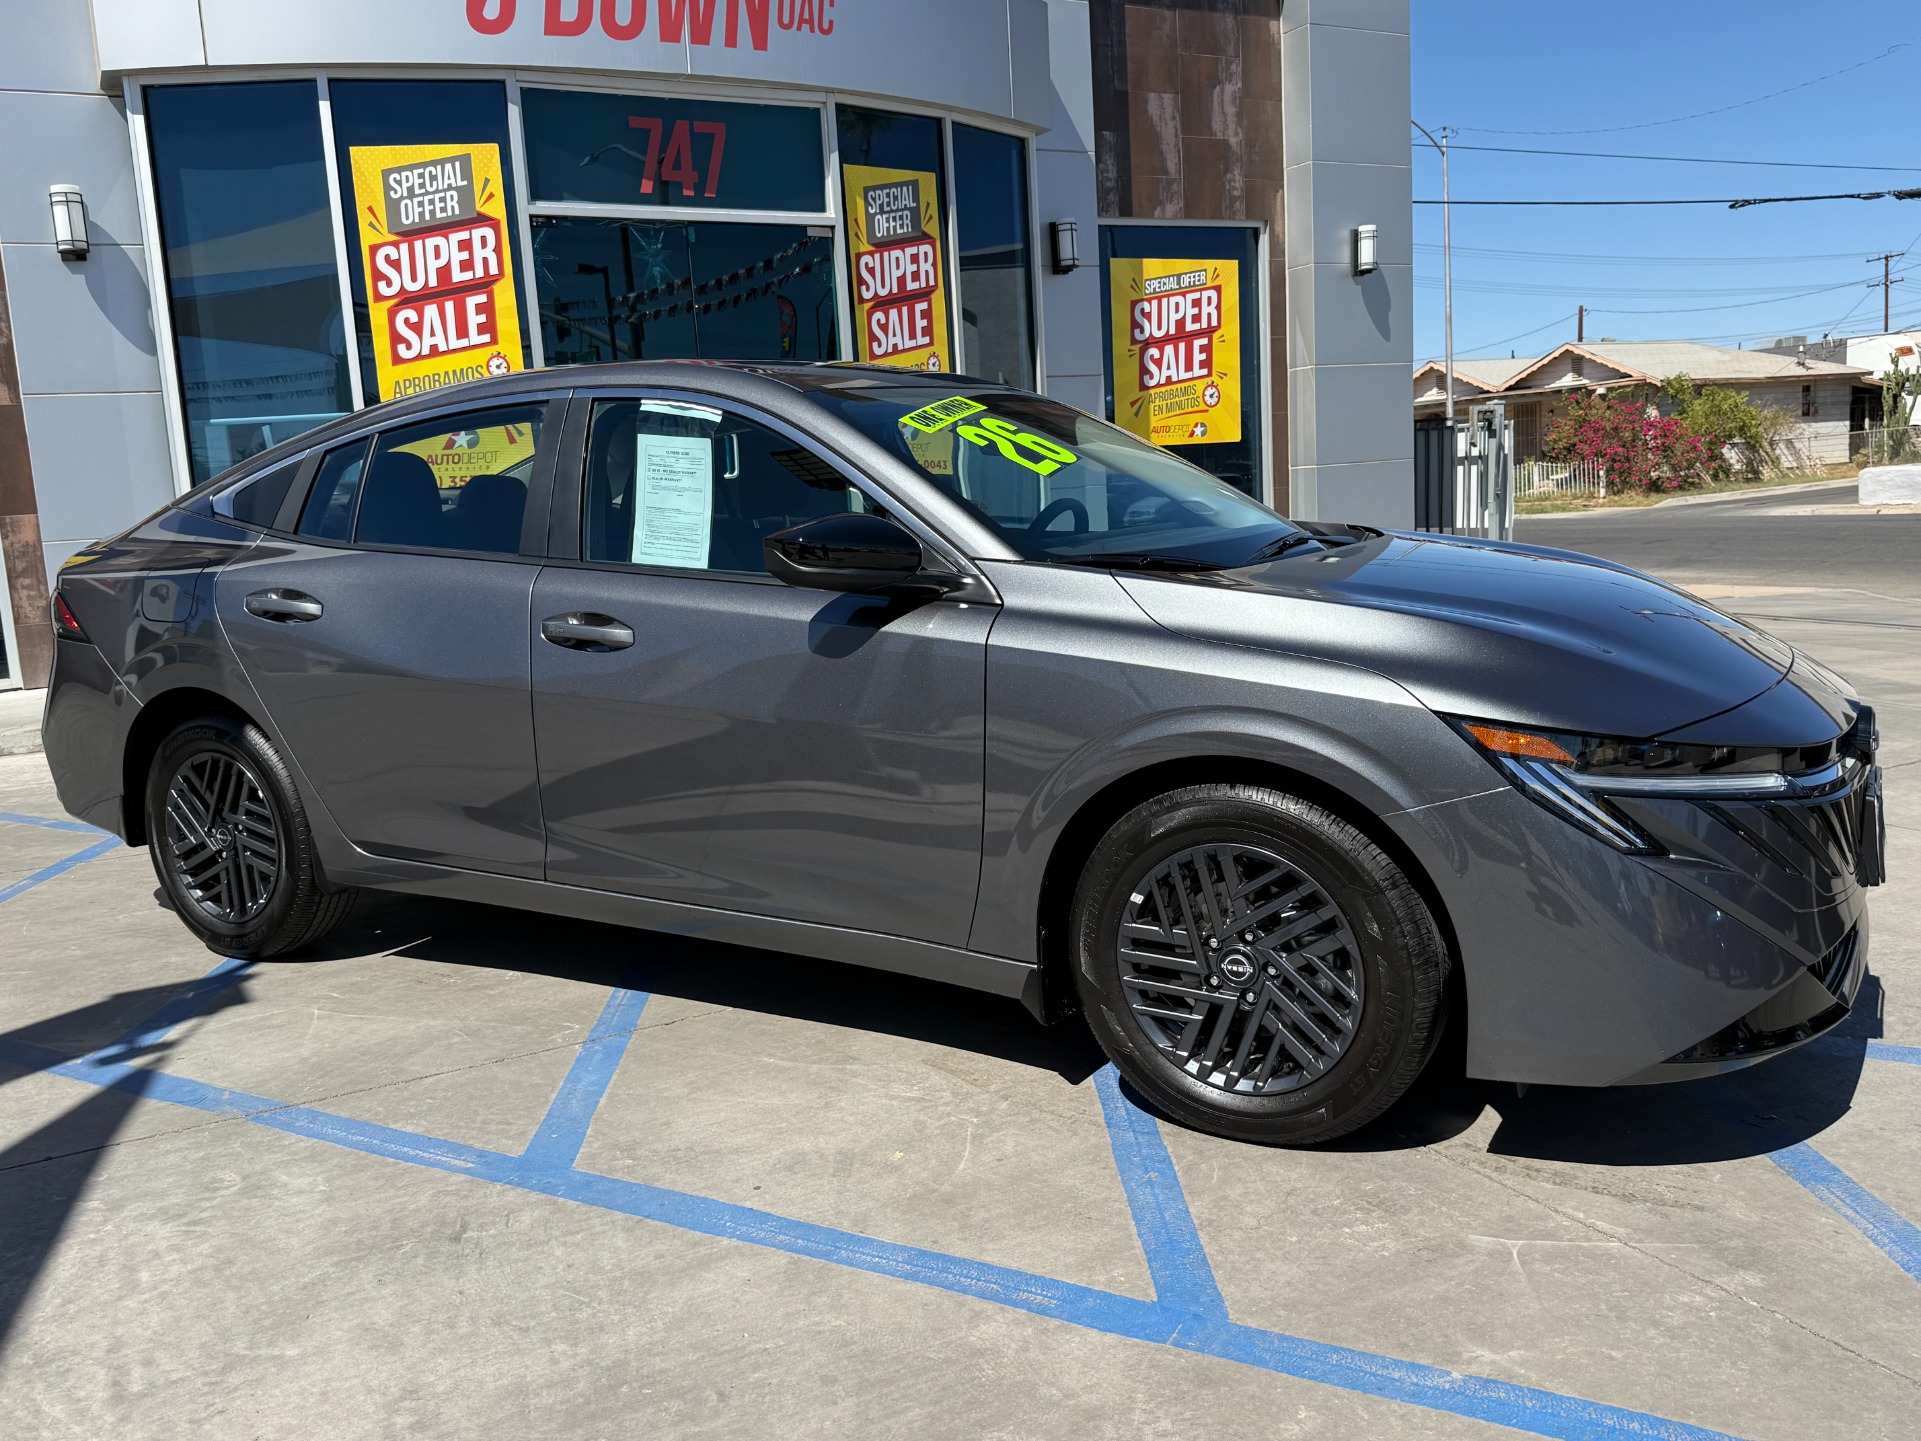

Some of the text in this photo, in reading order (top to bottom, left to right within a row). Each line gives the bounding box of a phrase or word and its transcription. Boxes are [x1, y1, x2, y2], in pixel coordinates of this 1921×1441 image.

[628, 116, 727, 197] 747
[388, 161, 468, 199] SPECIAL
[400, 190, 460, 225] OFFER
[867, 185, 916, 214] SPECIAL
[874, 211, 912, 238] OFFER
[375, 226, 500, 298] SUPER
[859, 244, 936, 300] SUPER
[1144, 274, 1207, 294] SPECIAL OFFER
[395, 293, 492, 360] SALE
[871, 301, 931, 356] SALE
[1133, 289, 1219, 342] SUPER
[1143, 337, 1209, 388] SALE
[1148, 384, 1197, 405] APROBAMOS
[1153, 396, 1201, 417] EN MINUTOS
[909, 410, 945, 427] ONE
[1151, 424, 1191, 434] AUTODEPOT
[426, 450, 501, 466] AUTODEPOT
[956, 417, 1078, 477] 26
